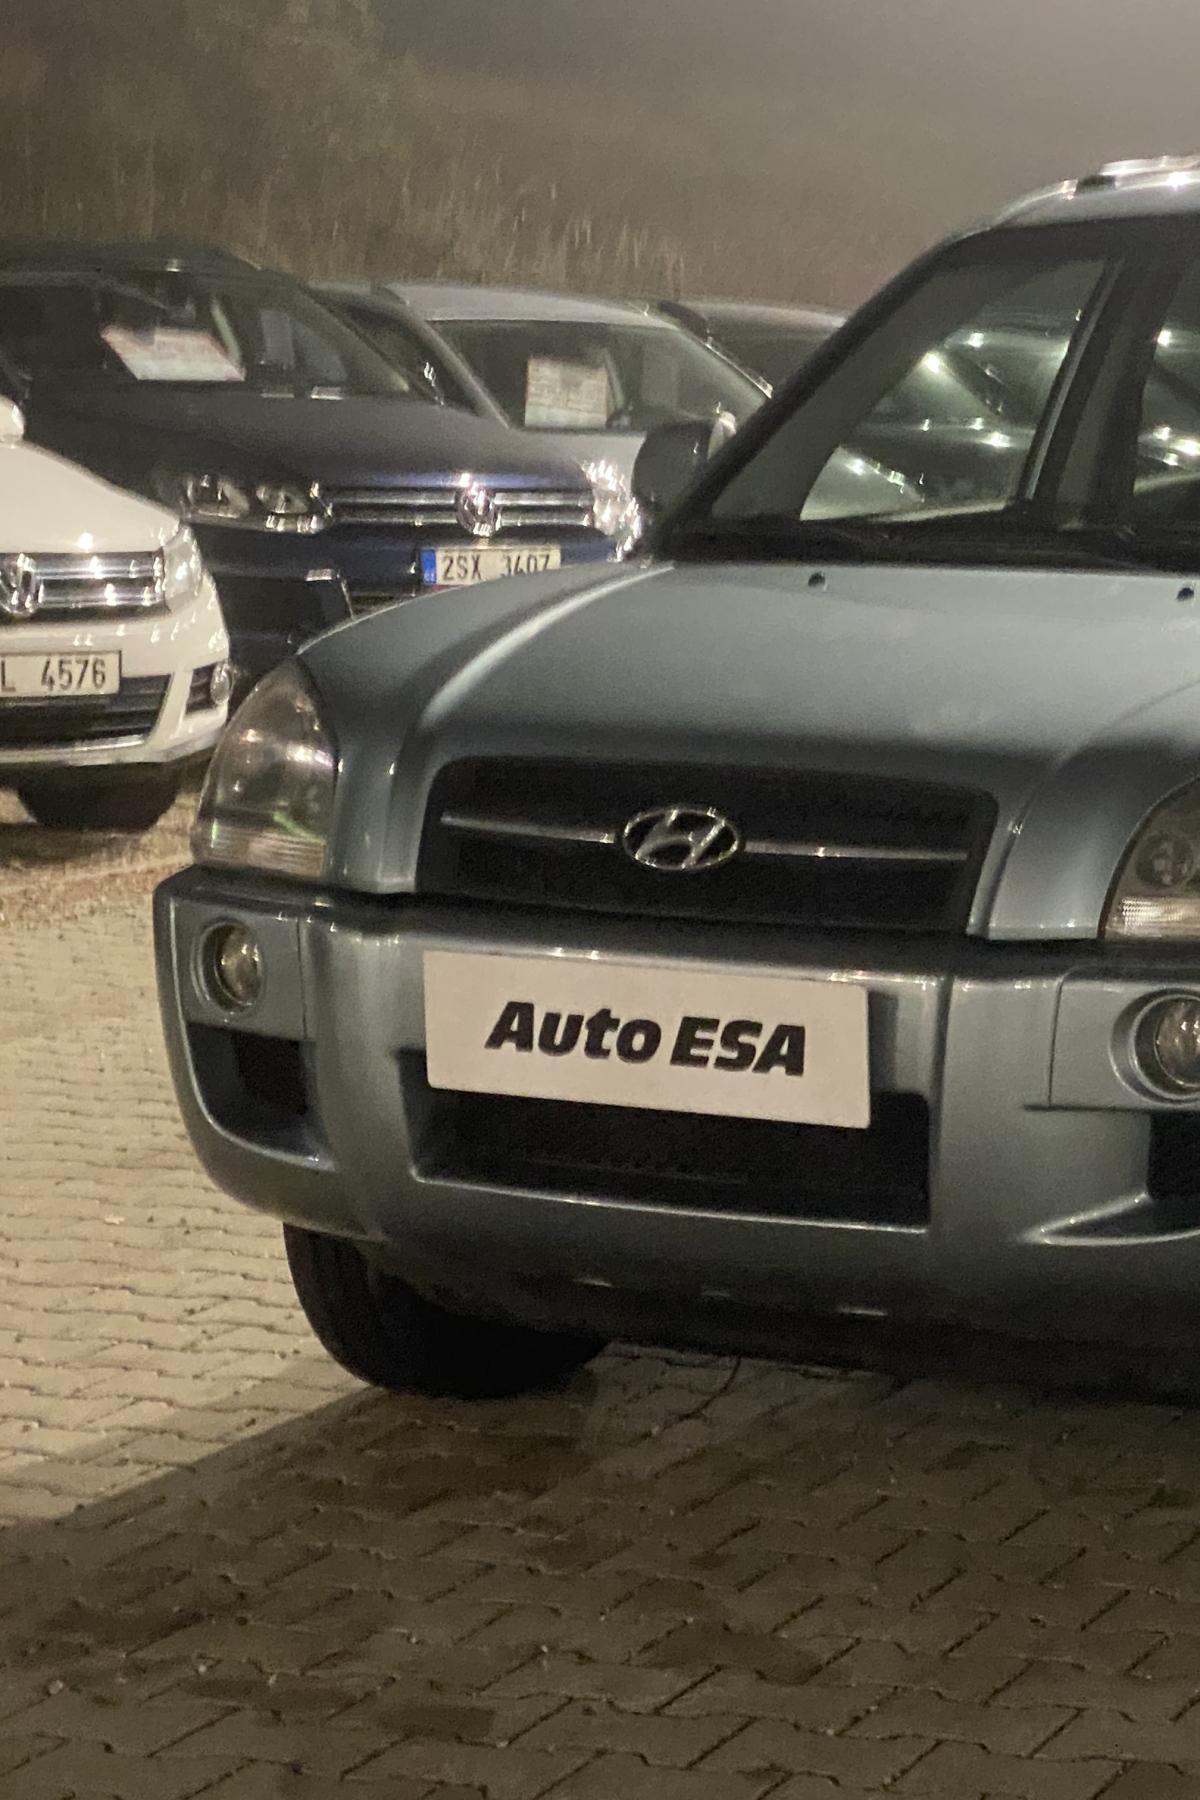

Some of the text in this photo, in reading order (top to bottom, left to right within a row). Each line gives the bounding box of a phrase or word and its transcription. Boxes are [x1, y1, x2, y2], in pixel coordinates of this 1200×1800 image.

[442, 554, 482, 581] 2SX
[41, 657, 106, 692] 4576
[484, 1001, 805, 1077] Auto ESA
